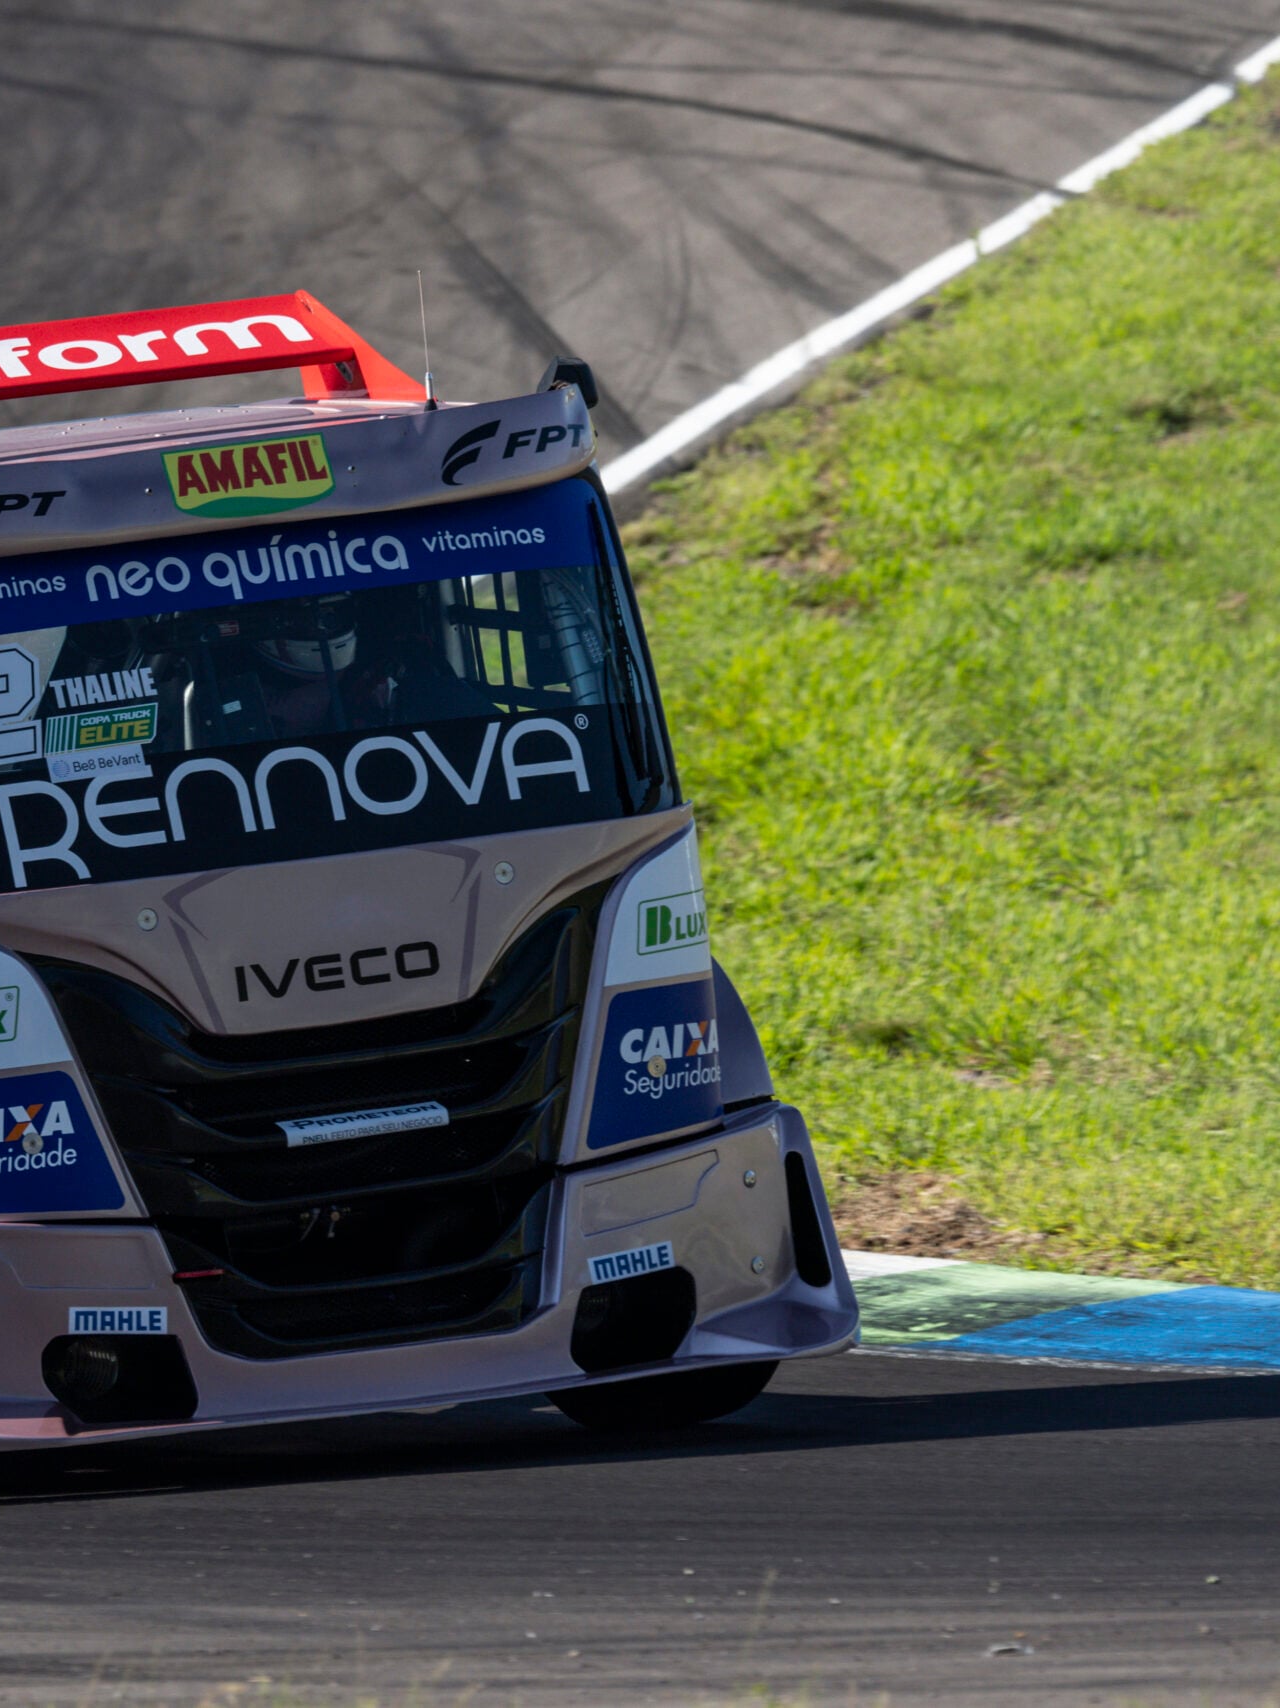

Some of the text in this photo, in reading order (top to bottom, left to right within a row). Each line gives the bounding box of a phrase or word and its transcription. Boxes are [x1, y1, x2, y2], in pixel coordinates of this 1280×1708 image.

[502, 423, 585, 459] FPT
[177, 438, 328, 497] AMAFIL
[86, 555, 190, 602] neo
[202, 529, 409, 600] química
[422, 525, 546, 553] vitaminas
[49, 667, 158, 709] THALINE
[80, 709, 151, 726] COPA TRUCK
[80, 719, 150, 745] ELITE
[73, 753, 141, 773] Be8 BeVant
[235, 941, 440, 1002] IVECO
[620, 1019, 719, 1065] CAIXA
[289, 1103, 439, 1130] PROMETEON
[330, 1129, 356, 1141] FEITO
[358, 1126, 381, 1136] PARA
[382, 1123, 400, 1133] SEU
[593, 1244, 671, 1281] MAHLE
[74, 1309, 162, 1332] MAHLE
